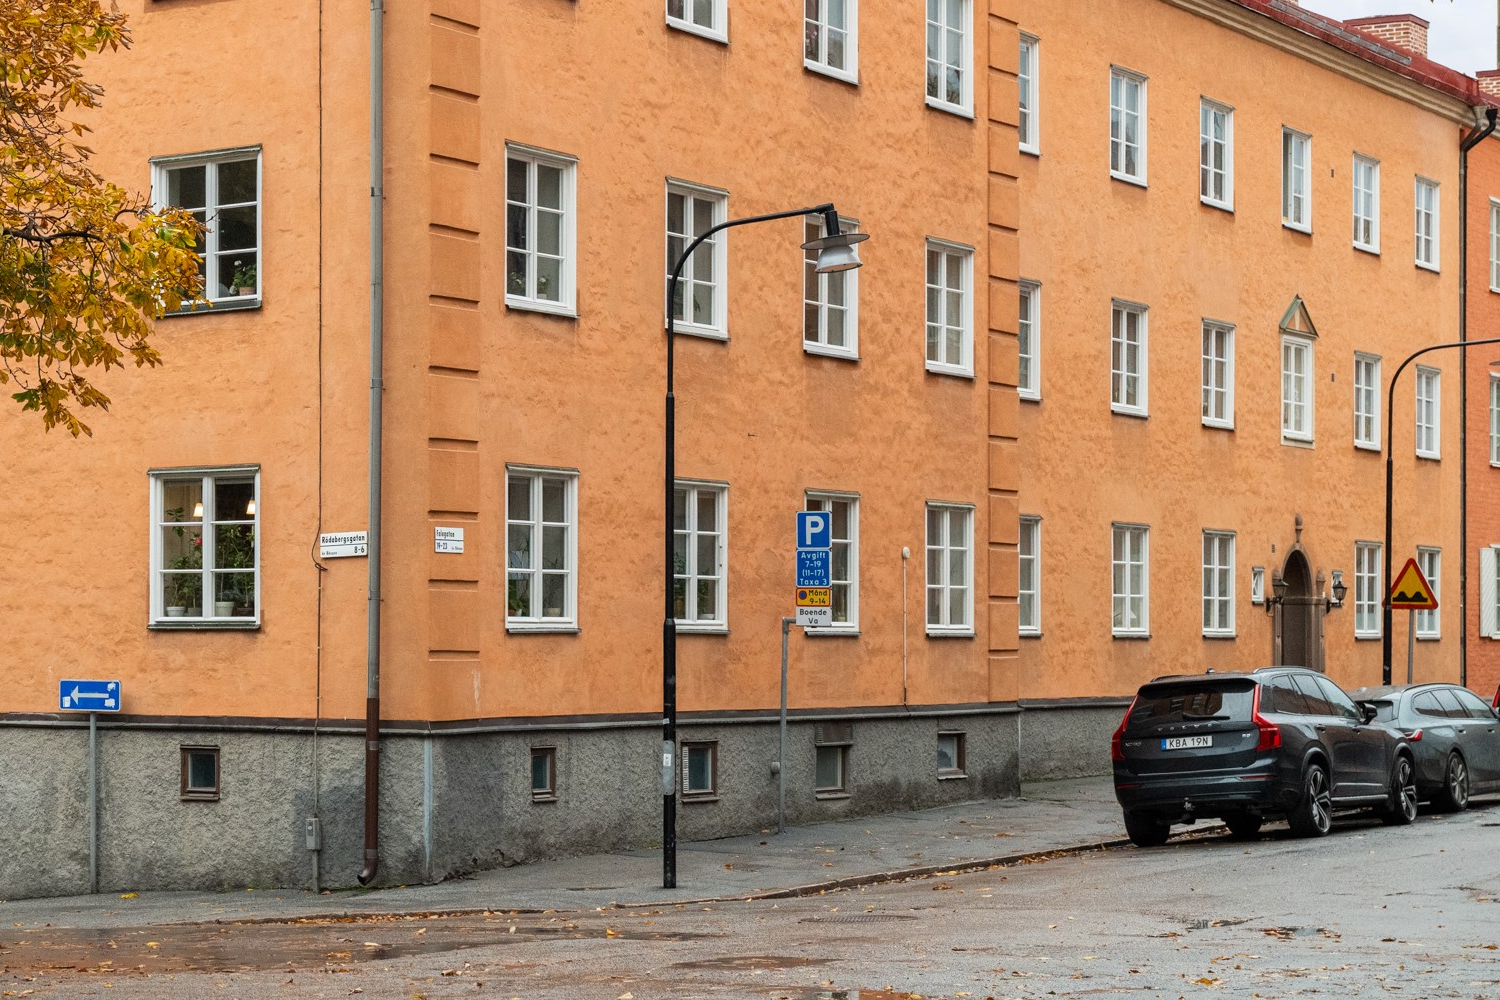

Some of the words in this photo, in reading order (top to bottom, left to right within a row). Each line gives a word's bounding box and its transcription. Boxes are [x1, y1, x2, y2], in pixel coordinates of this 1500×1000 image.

[806, 516, 824, 545] P
[321, 535, 366, 544] Rödabergsgatan
[354, 546, 365, 554] 8-6
[801, 552, 826, 560] Avgift
[802, 569, 825, 577] (11-17)
[799, 608, 827, 616] Boende
[1169, 738, 1188, 748] KBA
[1191, 736, 1209, 746] 19N
